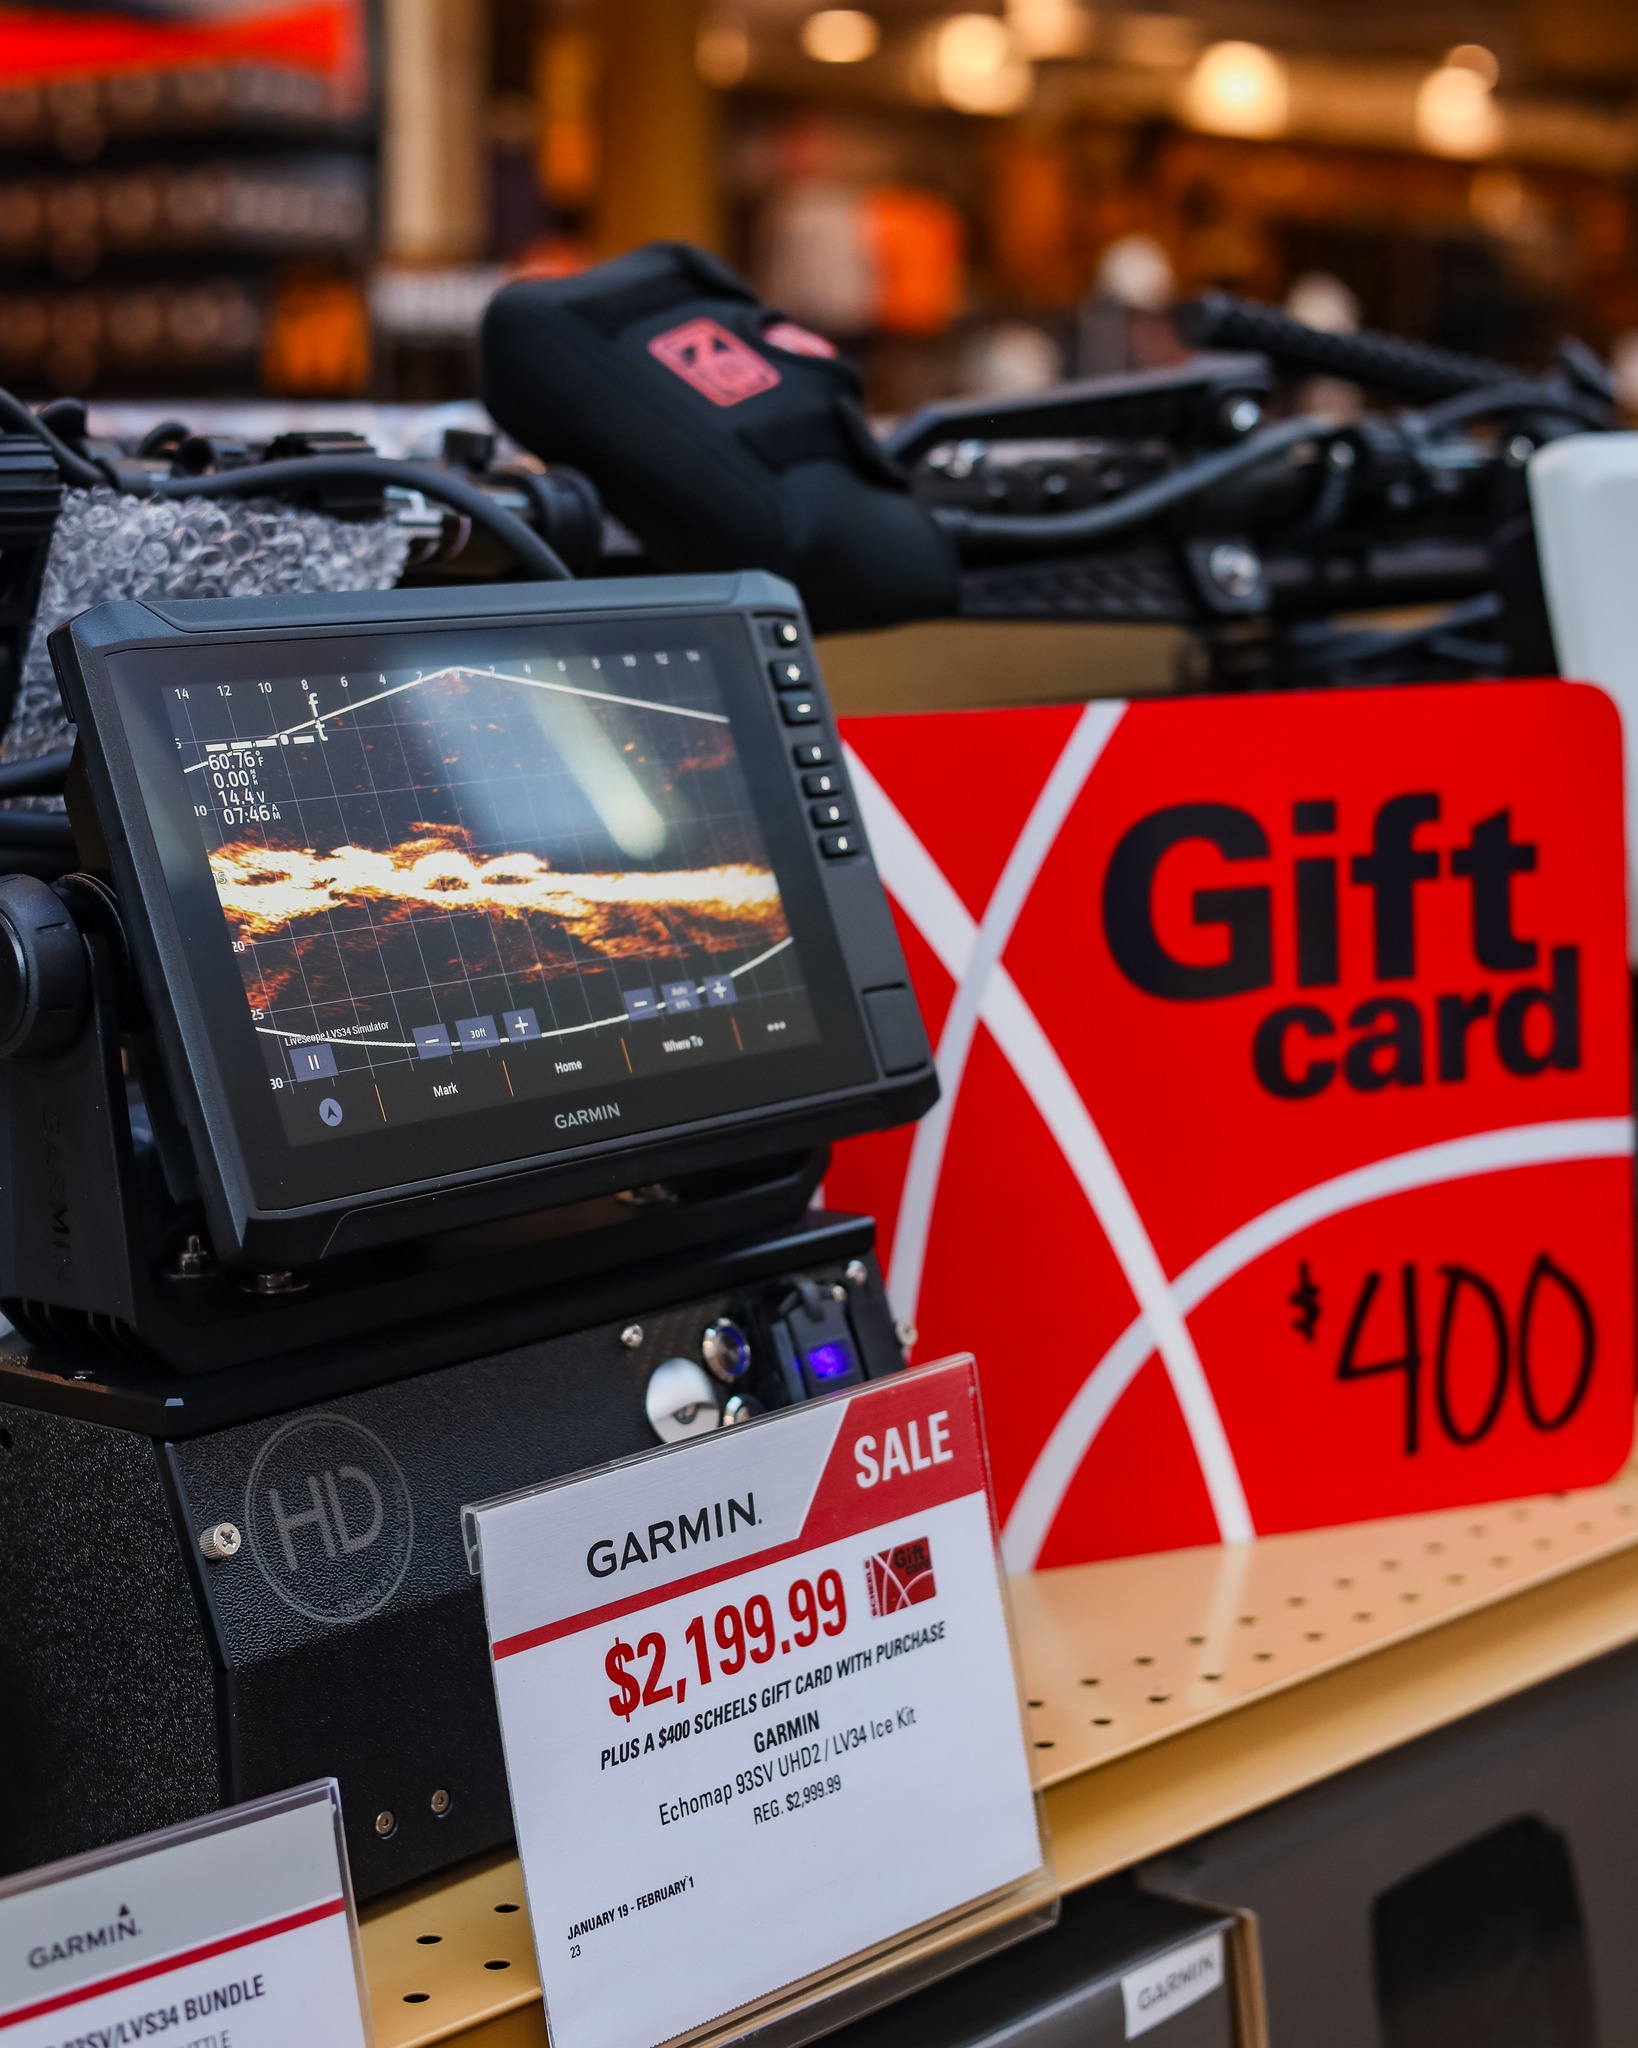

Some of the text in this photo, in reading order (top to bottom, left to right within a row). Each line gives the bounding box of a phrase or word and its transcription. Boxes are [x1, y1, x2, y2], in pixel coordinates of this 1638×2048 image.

[174, 688, 189, 700] 14
[217, 685, 232, 697] 12
[258, 682, 272, 694] 10
[301, 679, 309, 690] 8
[340, 676, 348, 688] 6
[218, 788, 254, 807] 14.4
[194, 805, 207, 817] 10
[223, 805, 270, 825] 07:46
[1101, 791, 1538, 1002] Gift
[232, 941, 245, 953] 20
[250, 1009, 264, 1021] 25
[1251, 945, 1583, 1101] card
[326, 1026, 351, 1040] LVS34
[352, 1021, 389, 1035] Simulator
[470, 1027, 487, 1039] 30ft
[662, 1039, 691, 1053] Where
[554, 1060, 583, 1074] Home
[270, 1077, 284, 1090] 30
[433, 1082, 459, 1098] Mark
[554, 1102, 620, 1129] GARMIN
[1288, 1251, 1596, 1457] $400
[853, 1410, 954, 1489] SALE
[605, 1568, 848, 1723] $2,199.99
[601, 1620, 945, 1771] PLUS A $400 SCHEELS GIFT CARD WITH PURCHASE
[754, 1709, 820, 1753] GARMIN
[659, 1784, 732, 1825] Echomap
[736, 1760, 773, 1794] 93SV
[778, 1743, 821, 1777] UHD2
[833, 1725, 867, 1755] LV34
[870, 1717, 893, 1740] Ice
[896, 1706, 916, 1729] Kit
[753, 1774, 842, 1825] REG. $2,999.99
[567, 1908, 615, 1940] JANUARY
[617, 1904, 629, 1918] 19
[636, 1878, 686, 1911] FEBRUARY
[688, 1876, 694, 1888] 1
[570, 1944, 581, 1959] 23
[185, 1974, 266, 2022] BUNDLE
